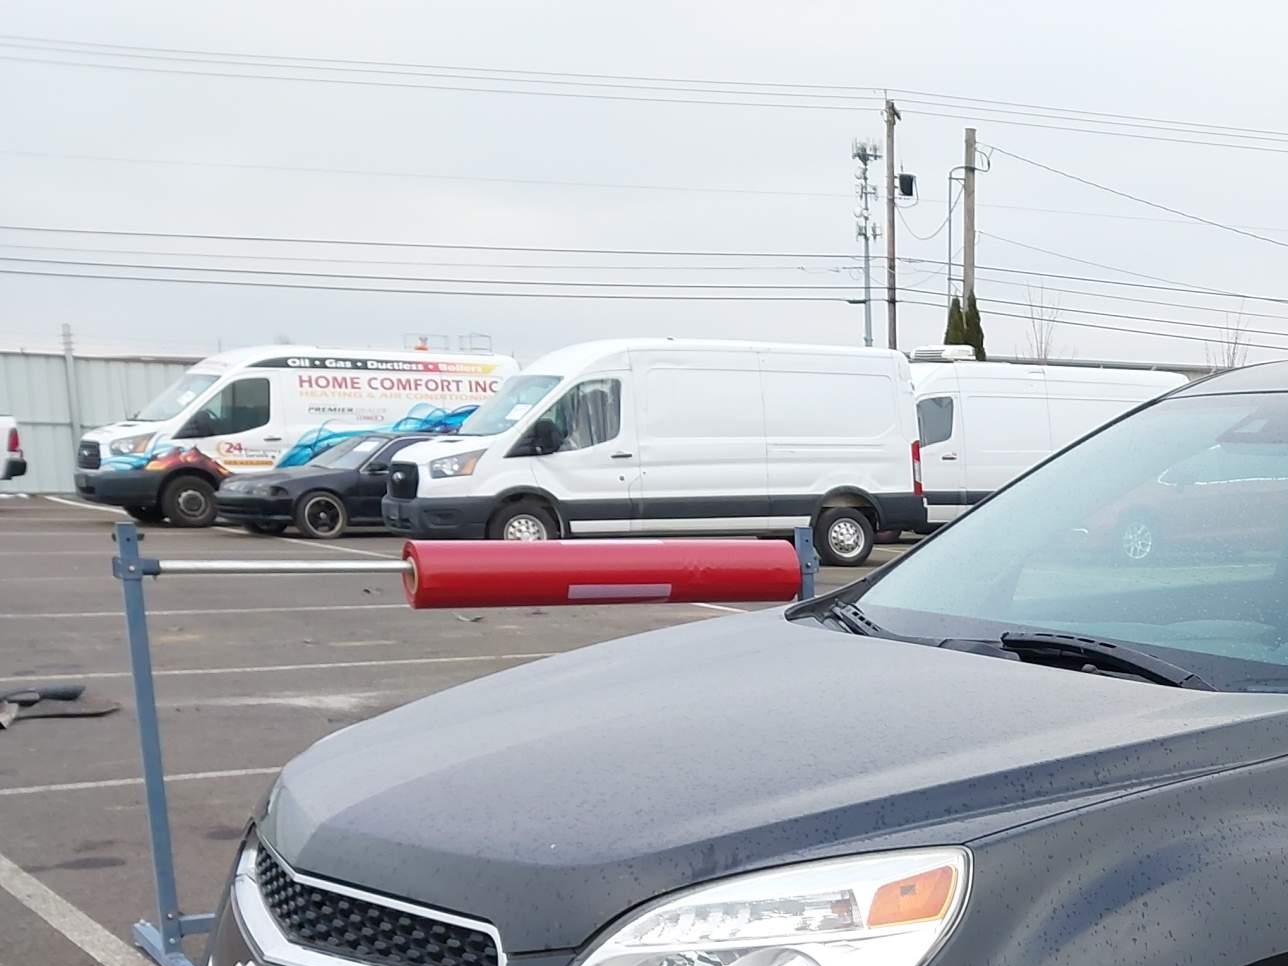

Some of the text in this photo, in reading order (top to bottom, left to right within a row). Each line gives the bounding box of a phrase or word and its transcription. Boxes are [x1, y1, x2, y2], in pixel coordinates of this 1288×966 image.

[287, 358, 310, 367] Oil
[324, 359, 352, 368] Gas
[366, 360, 424, 371] Ductless
[298, 375, 499, 393] HOME COMFORT INC
[299, 390, 362, 398] HEATING
[308, 406, 353, 414] PREMIER
[225, 442, 242, 453] 24
